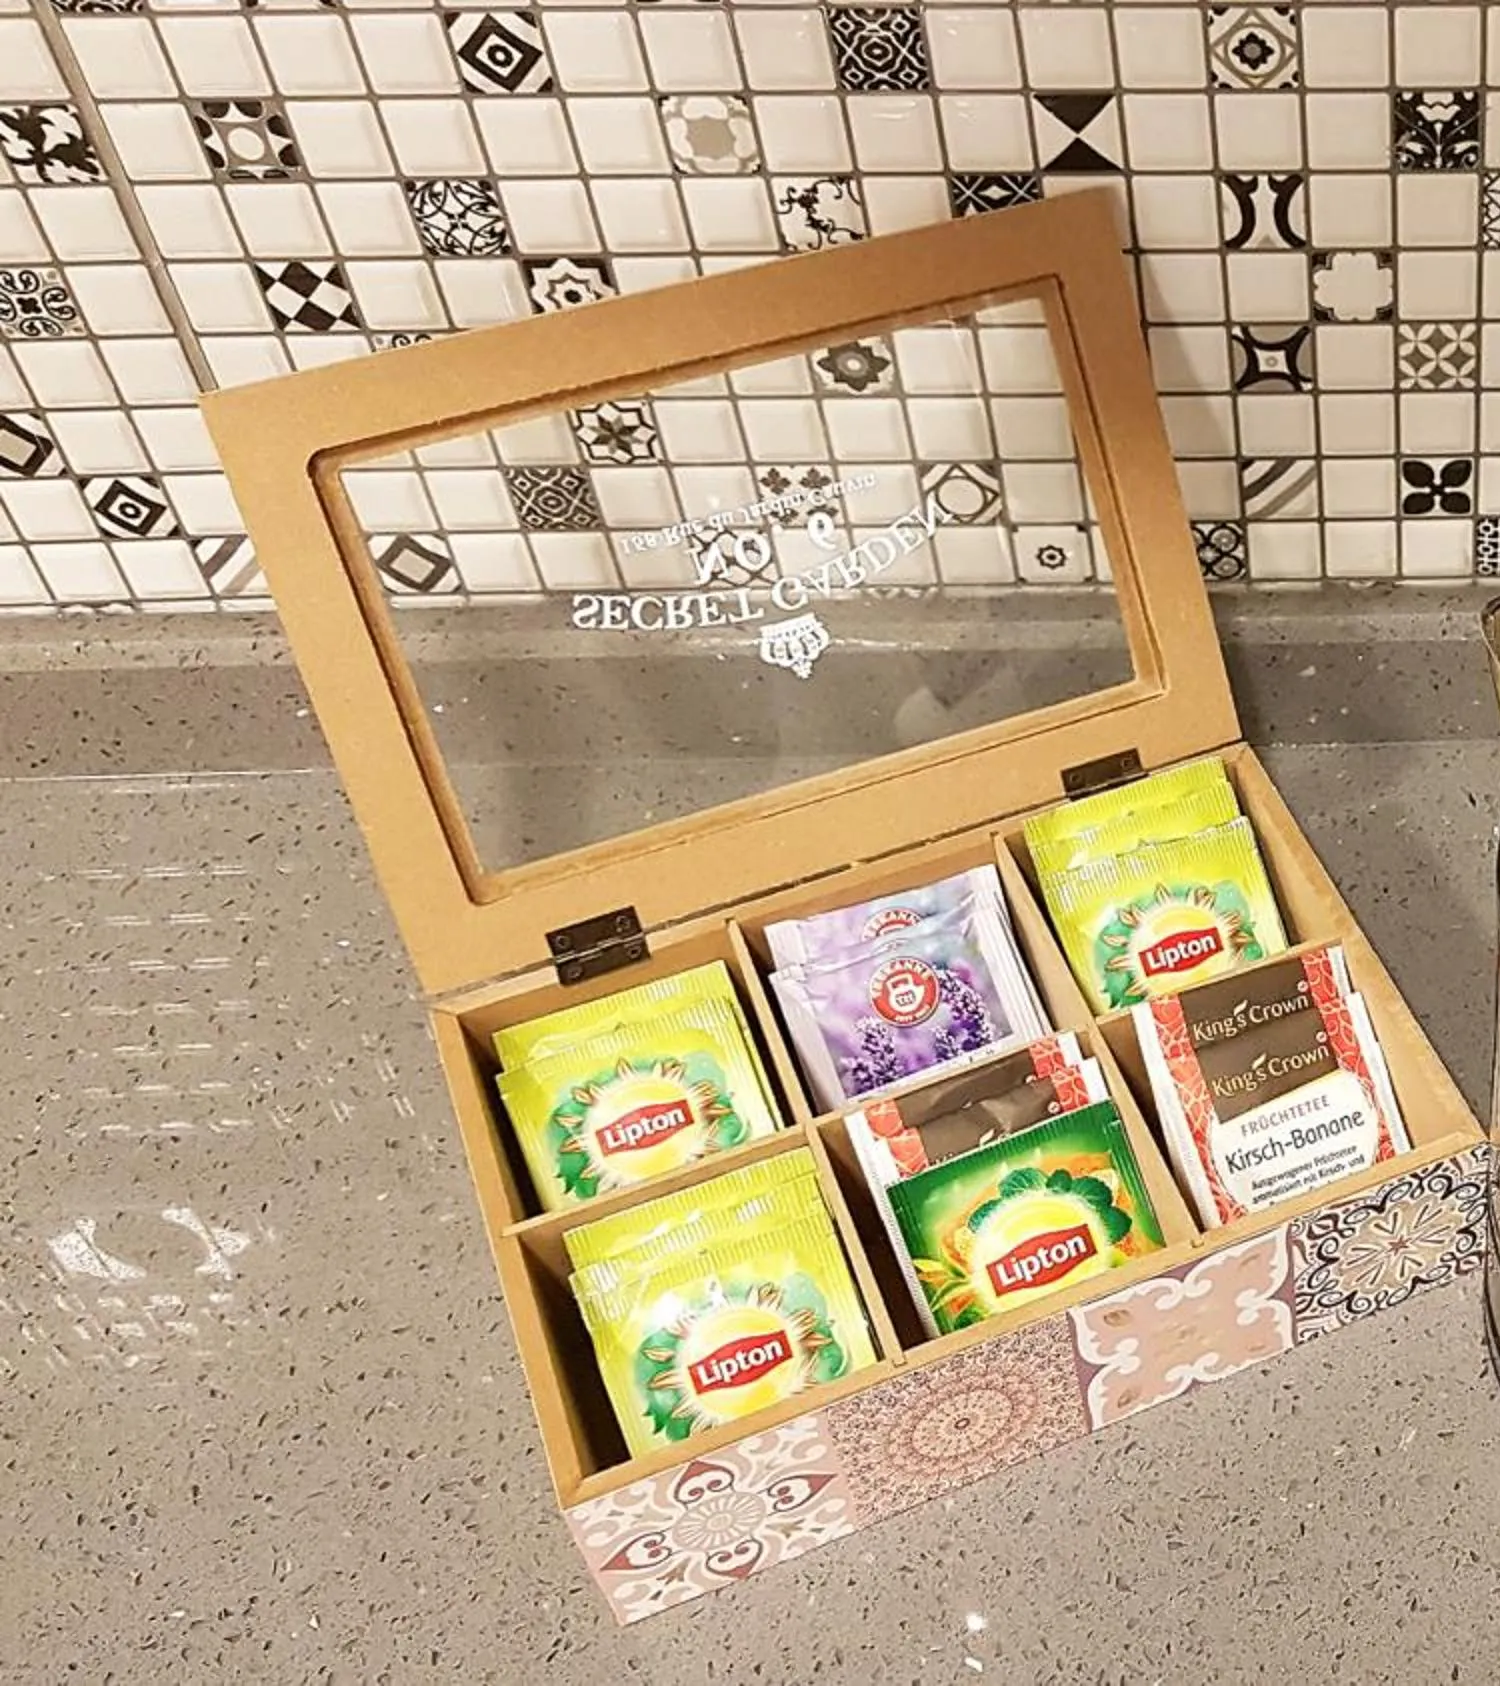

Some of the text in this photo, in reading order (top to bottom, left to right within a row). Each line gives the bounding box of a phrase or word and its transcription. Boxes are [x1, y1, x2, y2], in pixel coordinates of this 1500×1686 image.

[1146, 934, 1217, 971] Lipton
[1249, 992, 1310, 1024] Crown
[1269, 1044, 1329, 1078] Crown
[603, 1107, 686, 1150] Lipton
[1240, 1094, 1331, 1137] FRÜCHTETEE
[1225, 1109, 1366, 1175] Kirsch-Banane
[995, 1235, 1087, 1287] Lipton
[696, 1339, 783, 1386] Lipton
